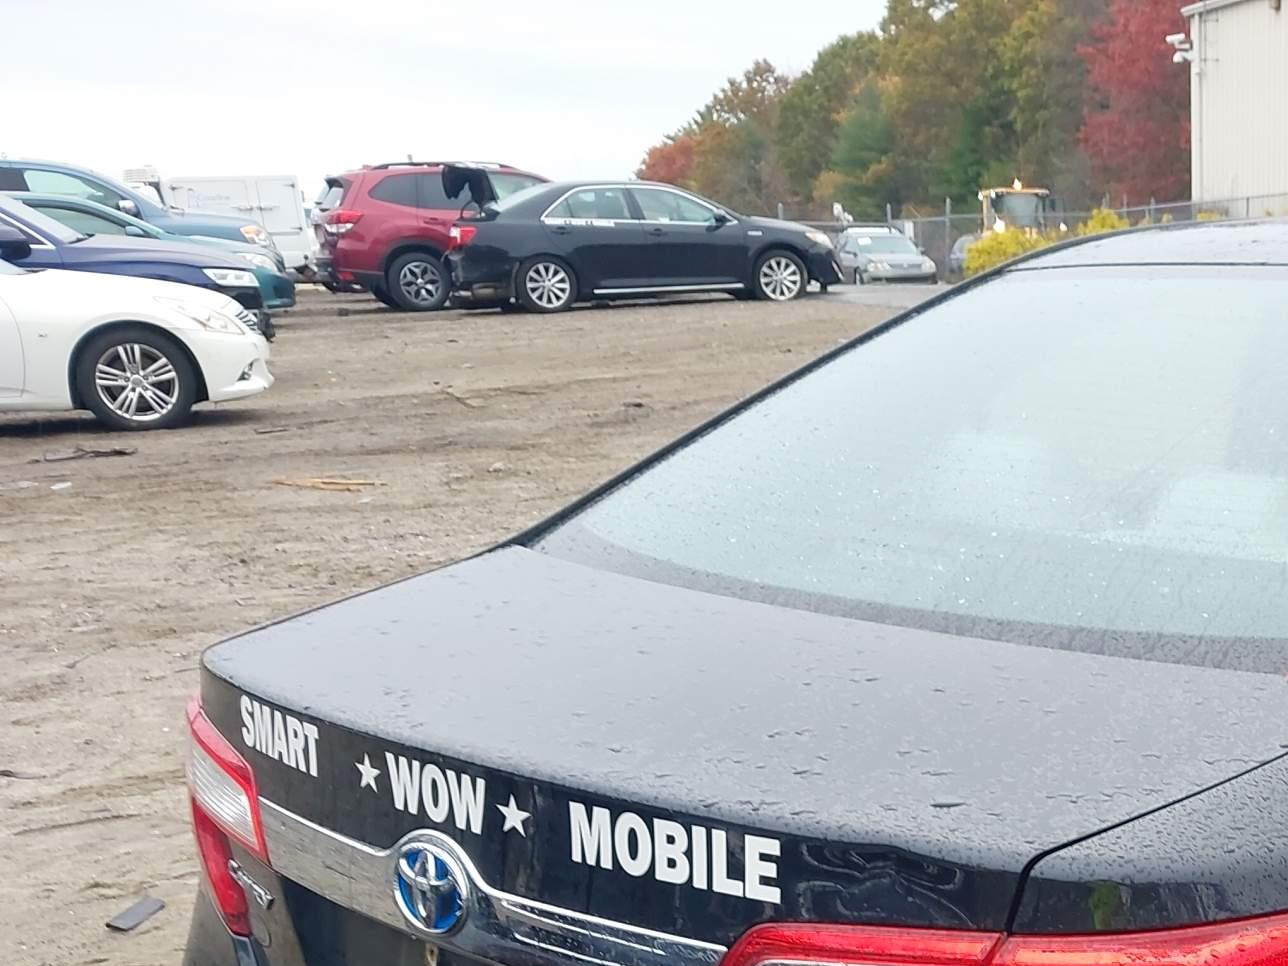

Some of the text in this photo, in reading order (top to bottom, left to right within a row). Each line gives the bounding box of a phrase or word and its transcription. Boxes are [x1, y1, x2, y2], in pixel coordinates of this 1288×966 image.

[240, 694, 782, 905] SMART WOW MOBILE
